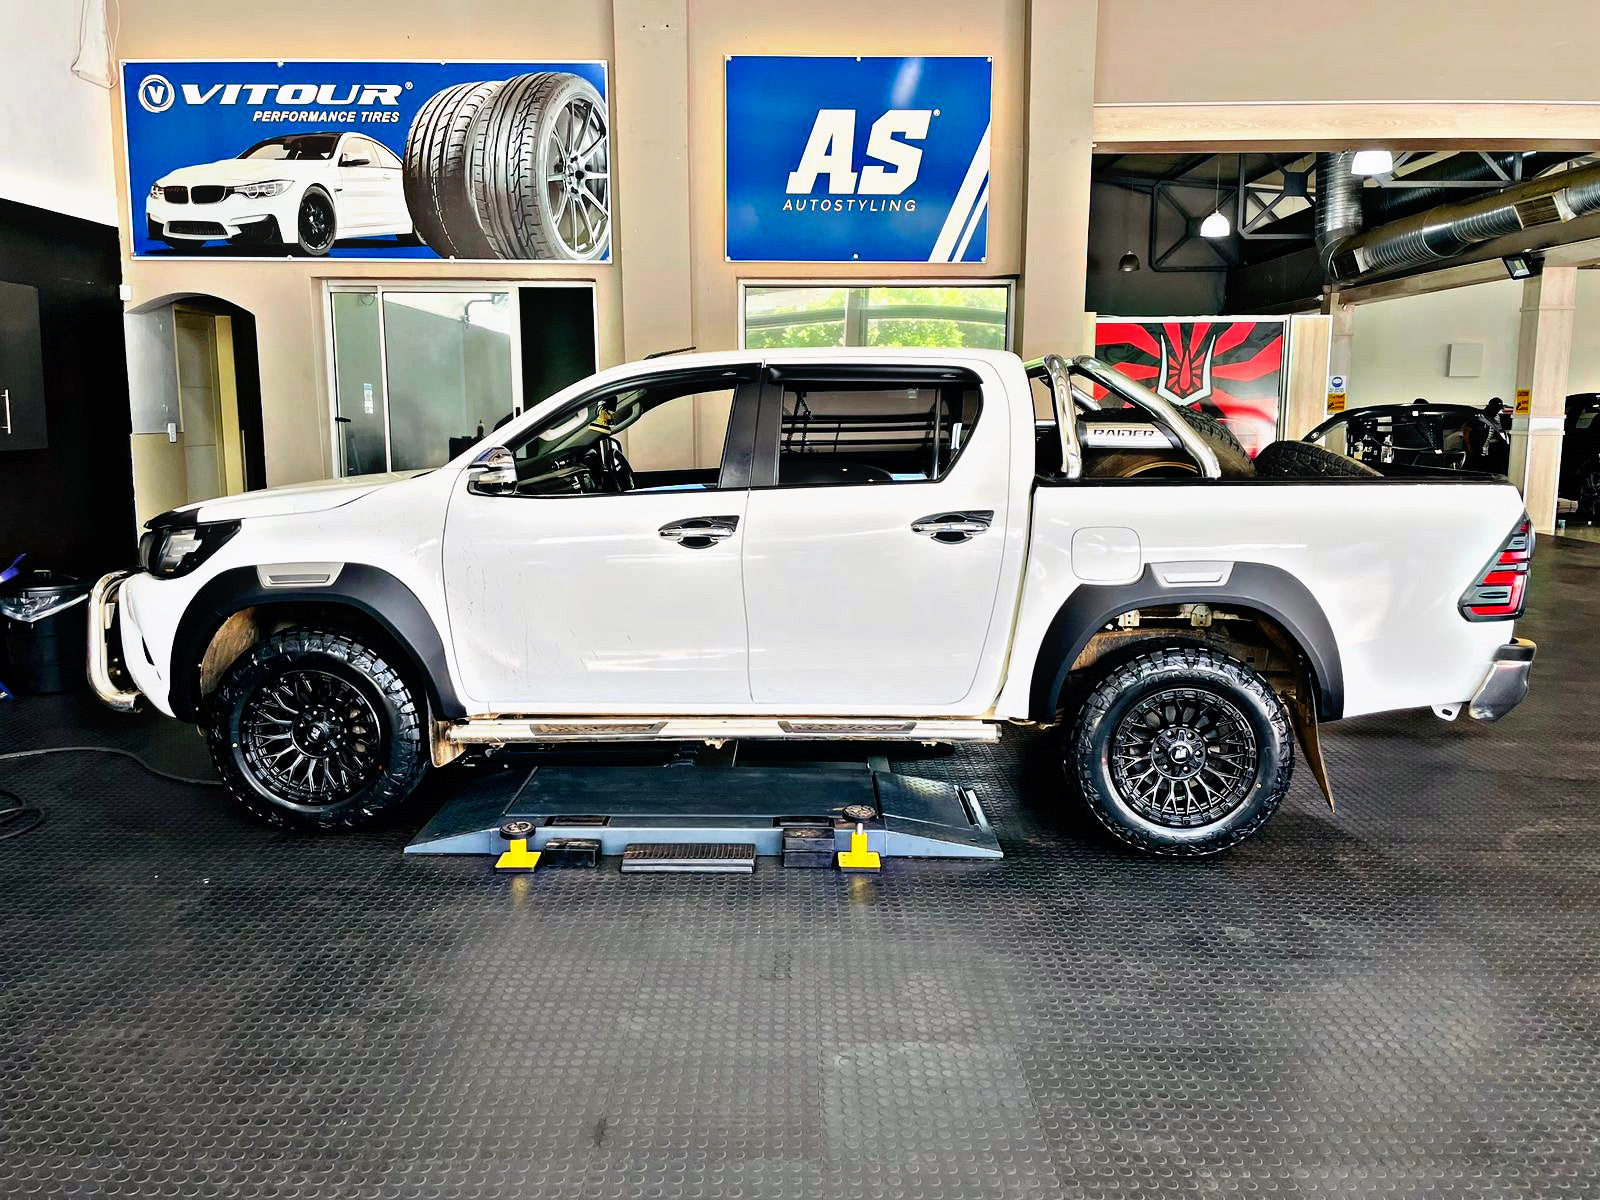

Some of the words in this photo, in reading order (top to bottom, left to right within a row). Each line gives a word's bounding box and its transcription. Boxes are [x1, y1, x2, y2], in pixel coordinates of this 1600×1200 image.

[181, 84, 403, 105] VITOUR
[252, 111, 356, 122] PERFORMANCE
[361, 111, 400, 122] TIRES
[785, 109, 932, 194] AS
[783, 199, 917, 212] AUTOSTYLING
[1093, 429, 1154, 437] RAIDER
